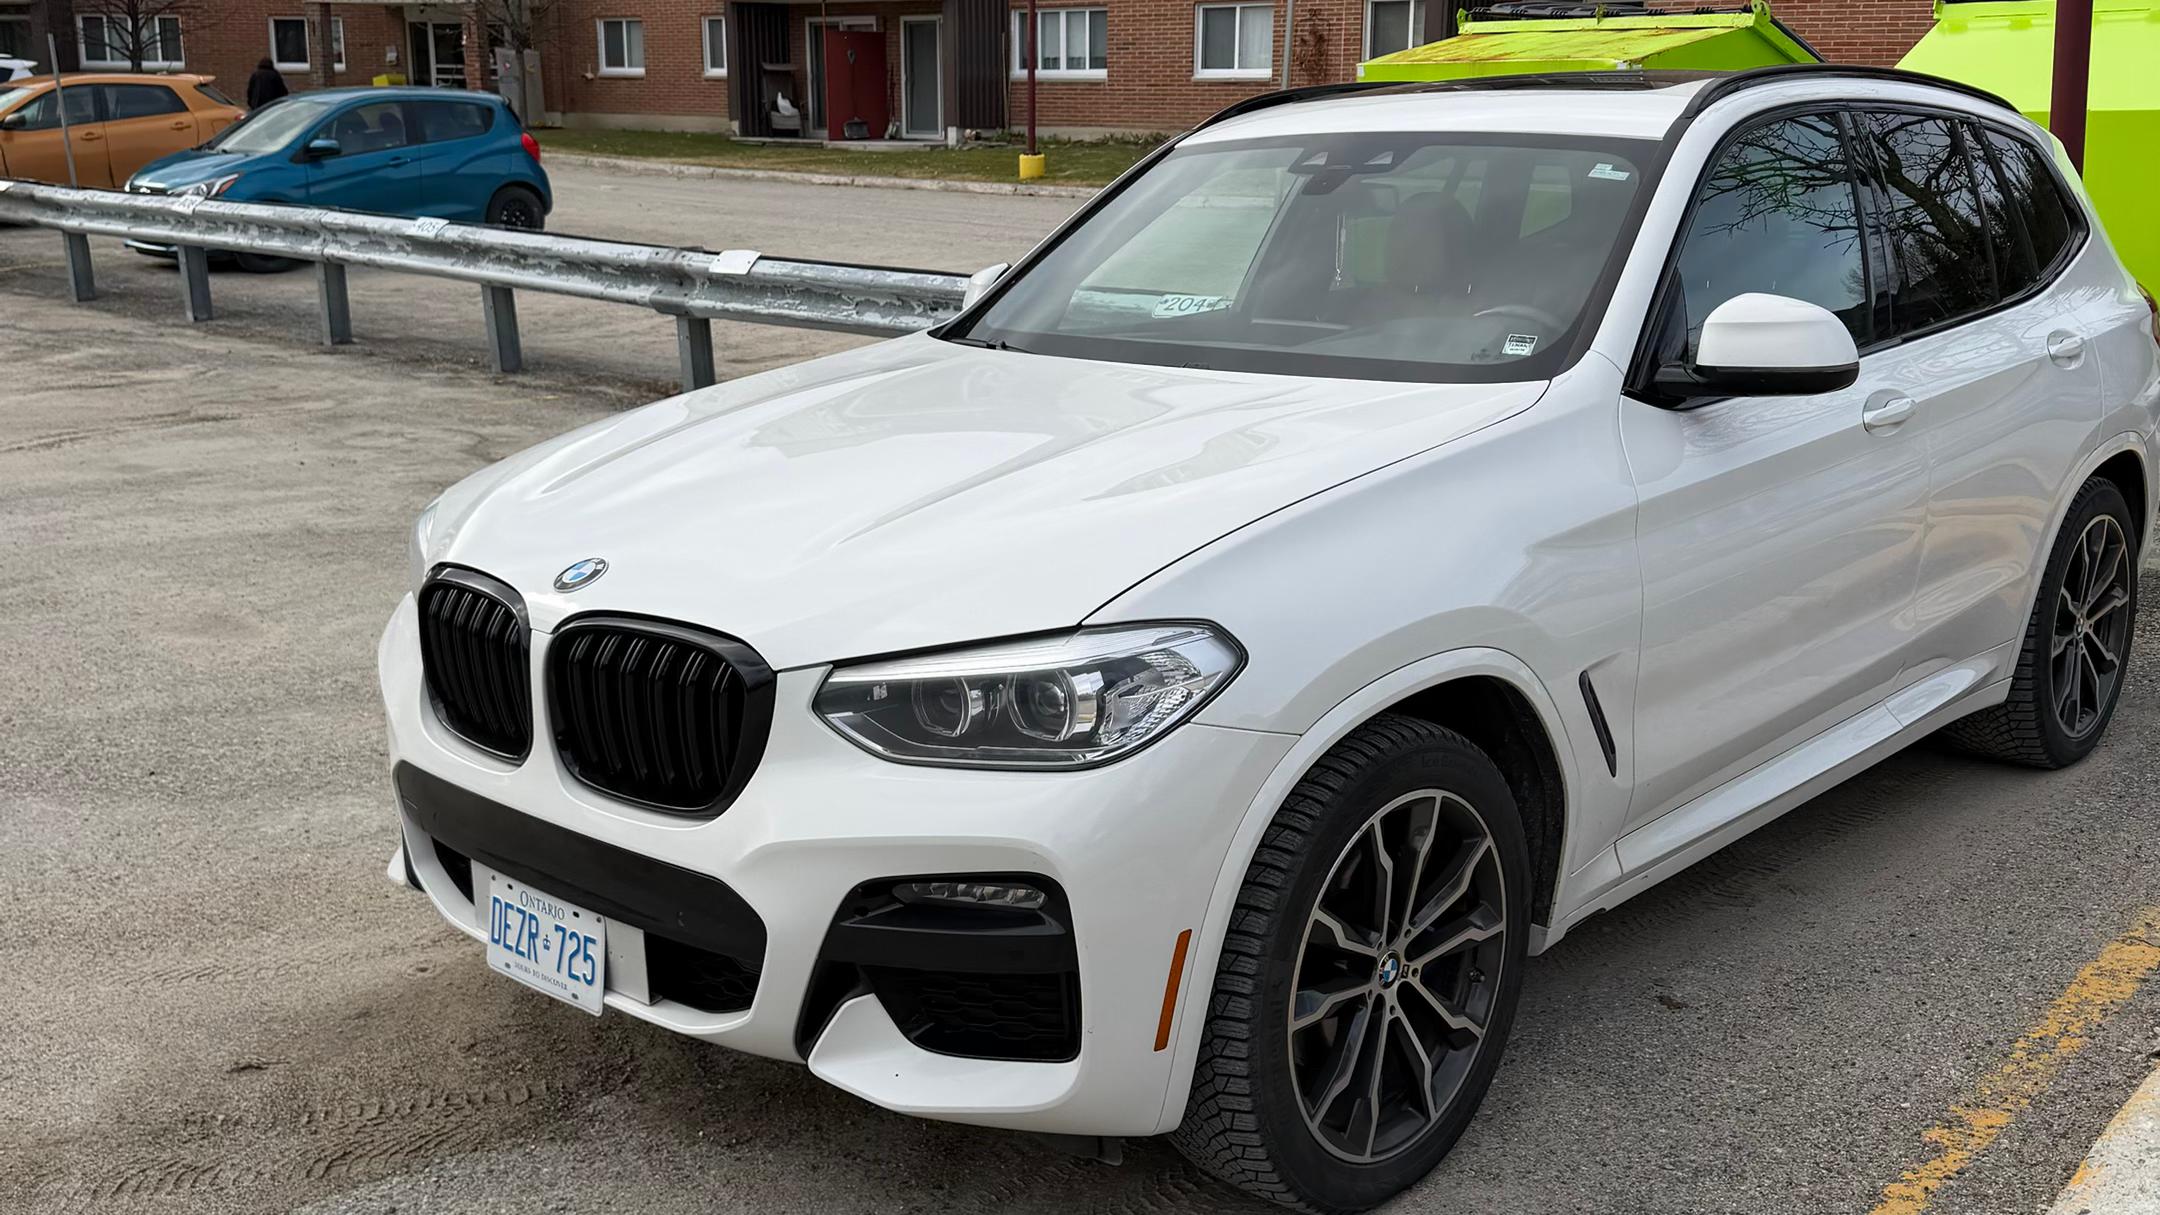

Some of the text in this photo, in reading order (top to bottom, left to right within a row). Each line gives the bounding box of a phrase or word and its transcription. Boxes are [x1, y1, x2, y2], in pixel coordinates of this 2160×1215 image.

[1163, 297, 1207, 312] 204
[519, 890, 565, 921] ONTARIO
[491, 895, 598, 987] DEZR 725
